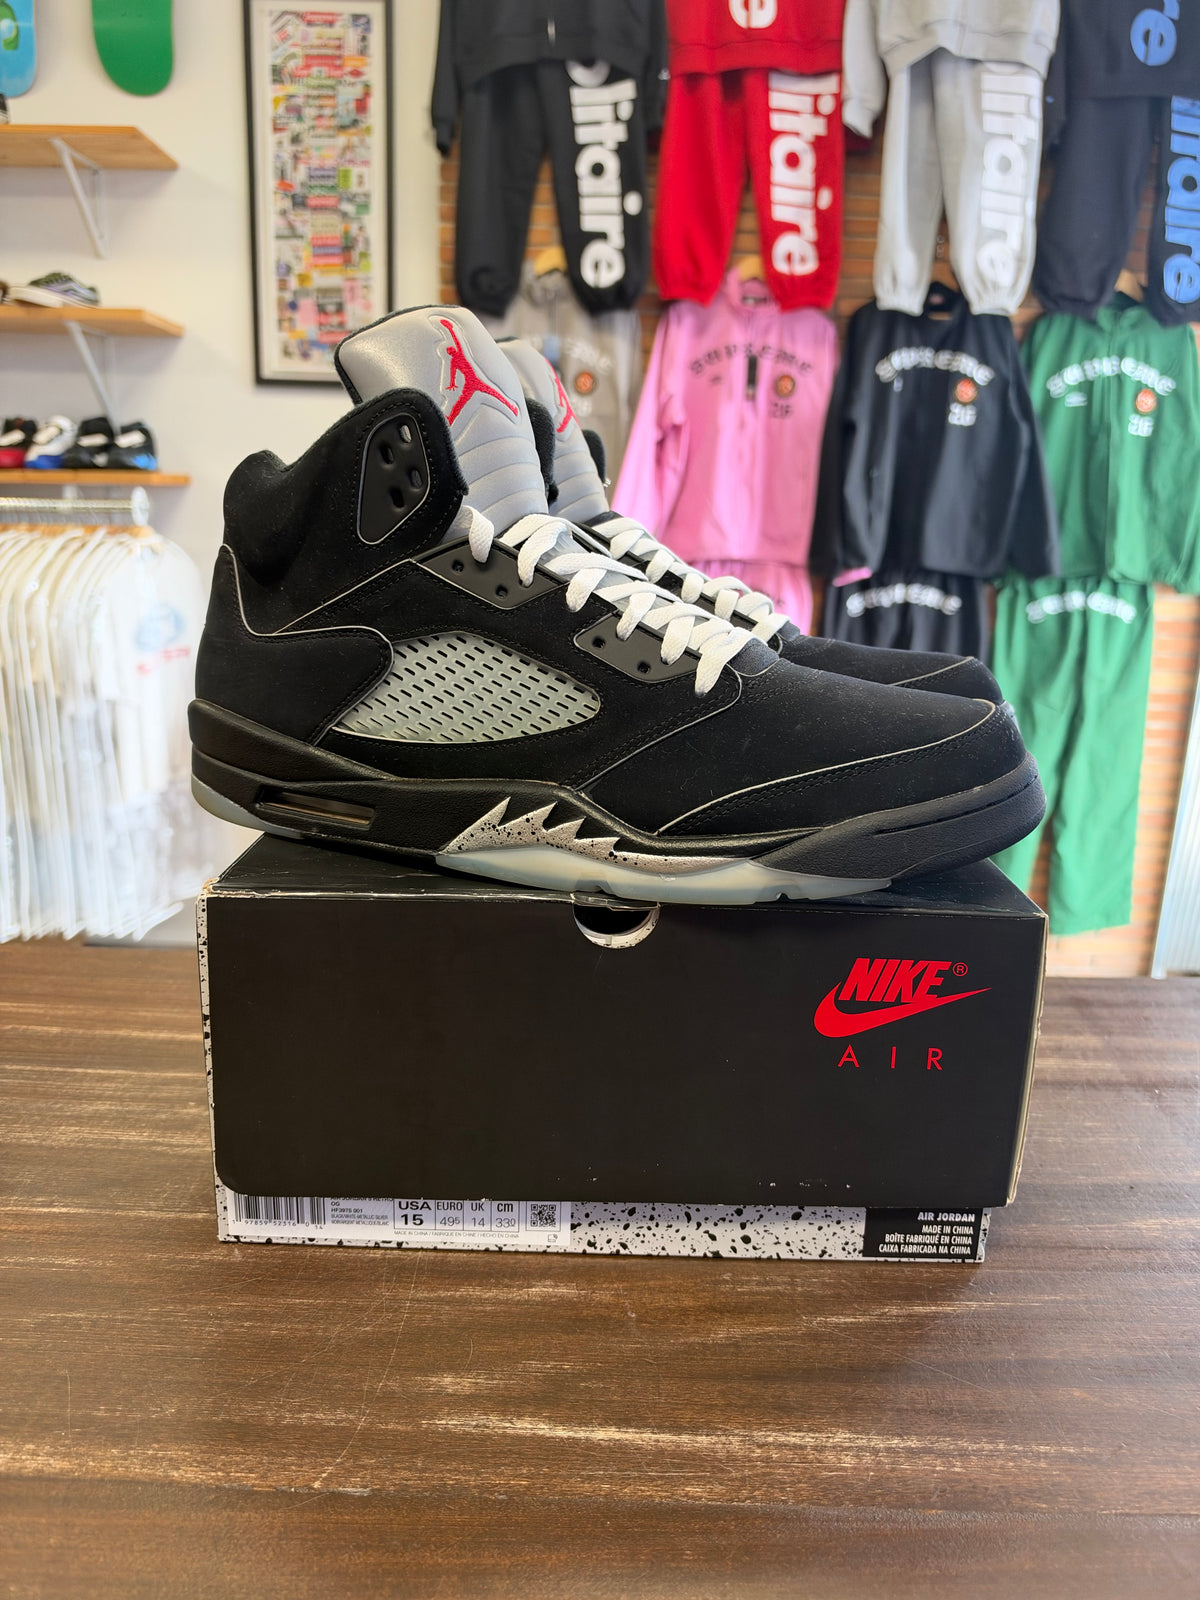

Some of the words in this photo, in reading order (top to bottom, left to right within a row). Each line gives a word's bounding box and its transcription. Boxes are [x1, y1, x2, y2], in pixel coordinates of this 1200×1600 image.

[976, 62, 1042, 287] litaire
[837, 1044, 943, 1070] AIR
[398, 1201, 432, 1211] USA
[437, 1201, 463, 1212] EURO
[470, 1202, 485, 1212] UK
[496, 1202, 514, 1213] cm
[400, 1213, 424, 1226] 15
[471, 1217, 486, 1228] 14
[917, 1211, 935, 1221] AIR
[937, 1212, 976, 1222] JORDAN
[921, 1224, 942, 1234] MADE
[943, 1225, 951, 1234] IN
[952, 1225, 974, 1235] CHINA
[885, 1232, 905, 1243] BOÎTE
[906, 1233, 939, 1244] FABRIQUÉ
[940, 1235, 950, 1244] EN
[951, 1235, 973, 1245] CHINA
[879, 1243, 899, 1253] CAIXA
[900, 1244, 937, 1254] FABRICADA
[938, 1244, 949, 1254] NA
[950, 1245, 971, 1255] CHINA
